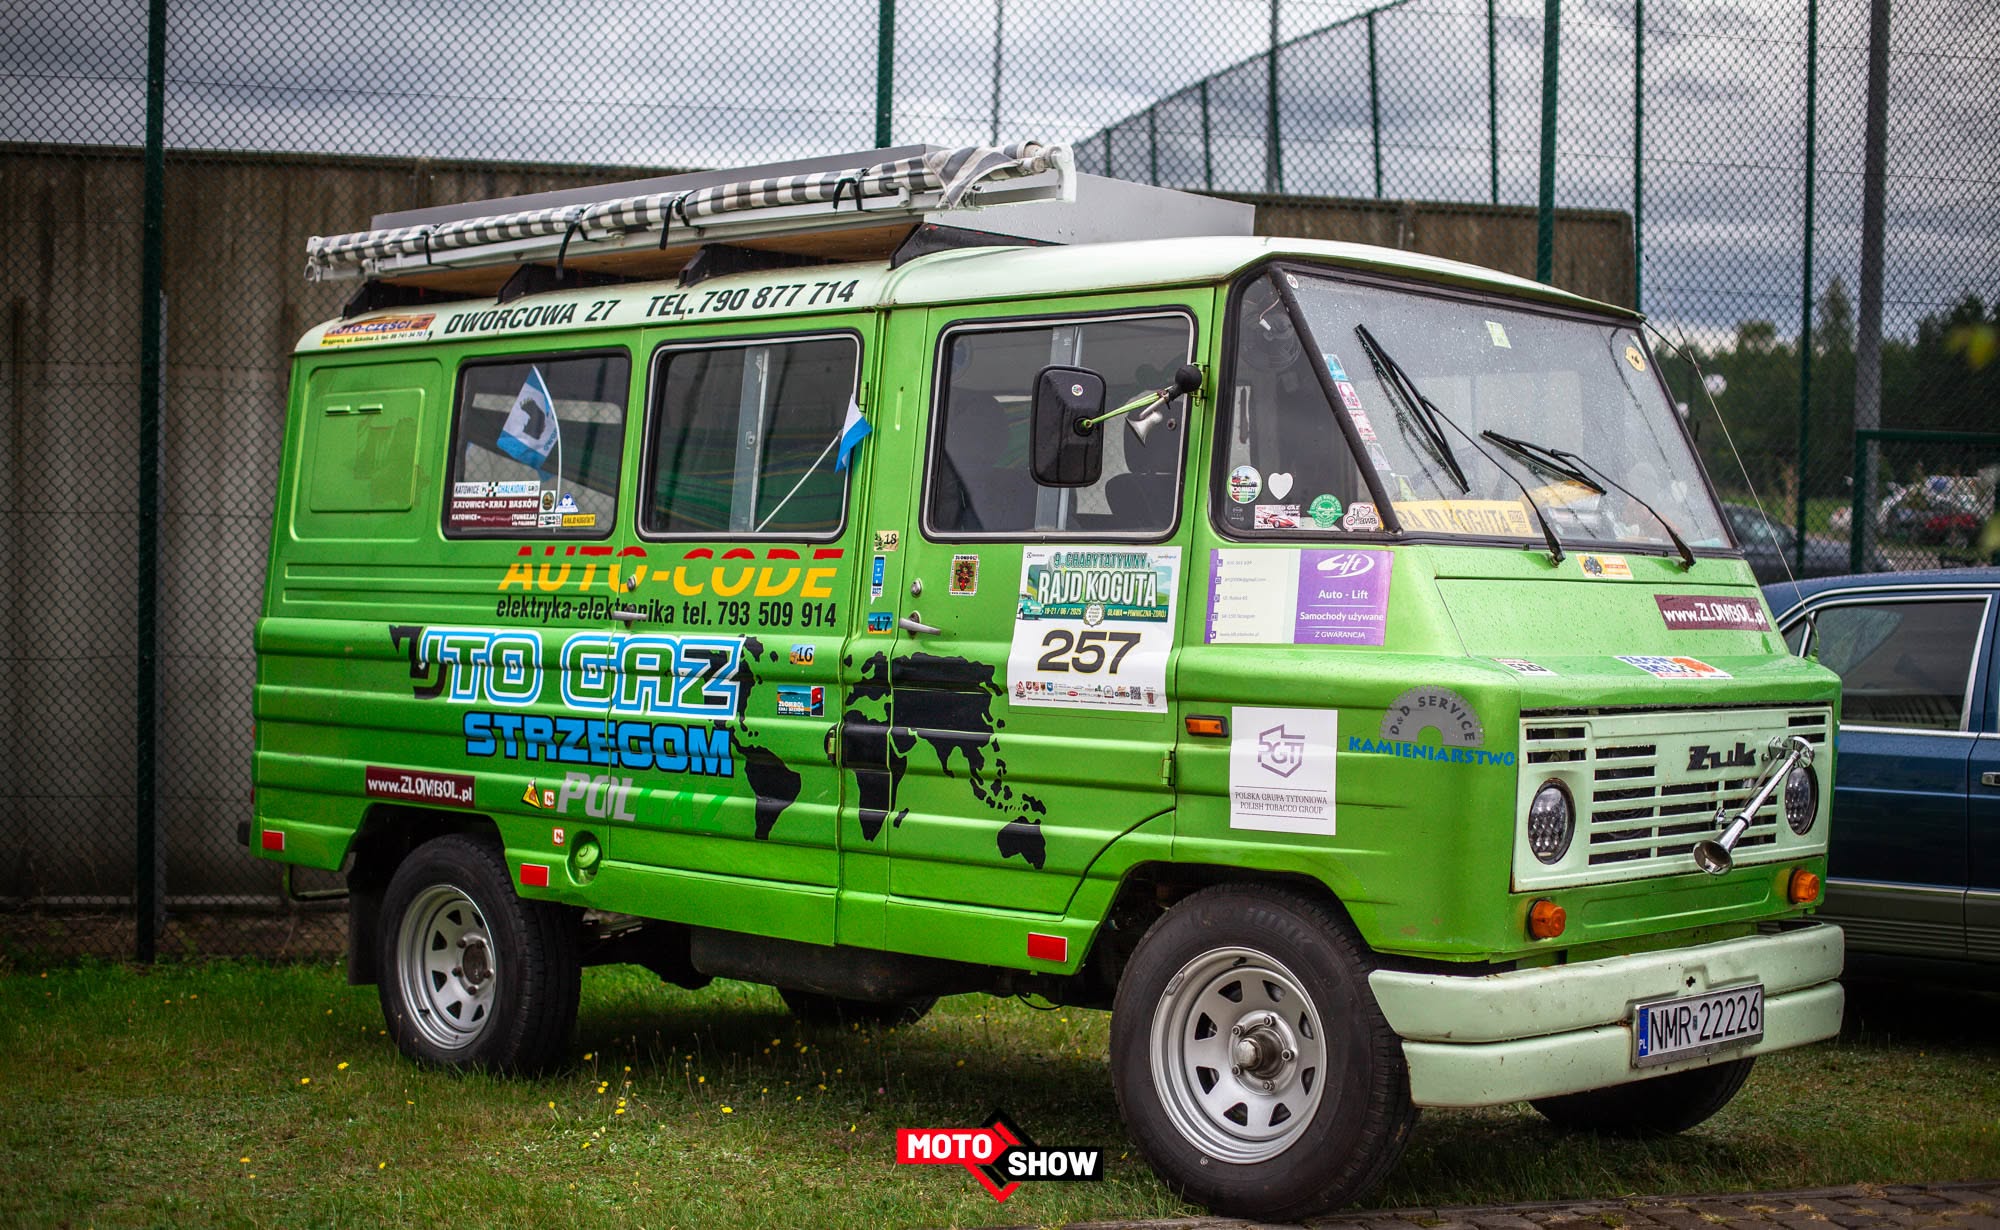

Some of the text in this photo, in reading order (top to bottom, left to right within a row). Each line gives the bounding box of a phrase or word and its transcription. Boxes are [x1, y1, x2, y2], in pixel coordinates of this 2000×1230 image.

[444, 280, 860, 335] DWORCOWA 27 TEL. 790 877 714
[331, 320, 411, 335] TO-CZĘŚCI
[456, 485, 480, 494] KATOWICE
[508, 498, 538, 509] BASKÓW
[884, 533, 897, 545] 18
[498, 546, 845, 598] AUTO-CODE
[1038, 570, 1157, 607] RAJD KOGUTA
[1318, 589, 1343, 599] Auto
[1352, 589, 1368, 599] Lift
[683, 600, 711, 625] tel.
[717, 601, 750, 626] 793
[758, 602, 792, 627] 509
[801, 602, 836, 628] 914
[875, 615, 891, 632] 17
[1300, 611, 1384, 622] Samochody używane
[797, 646, 814, 662] 16
[1037, 629, 1141, 674] 257
[560, 631, 747, 720] GAZ
[1418, 695, 1475, 742] SERVICE
[464, 711, 734, 777] STRZEGOM
[1348, 736, 1515, 767] KAMIENIARSTWO
[1235, 791, 1327, 805] POLSKA GRUPA TYTONIOWA
[1240, 801, 1323, 814] POLISH TOBACCO GROUP
[1638, 992, 1760, 1051] PL NMR 22226
